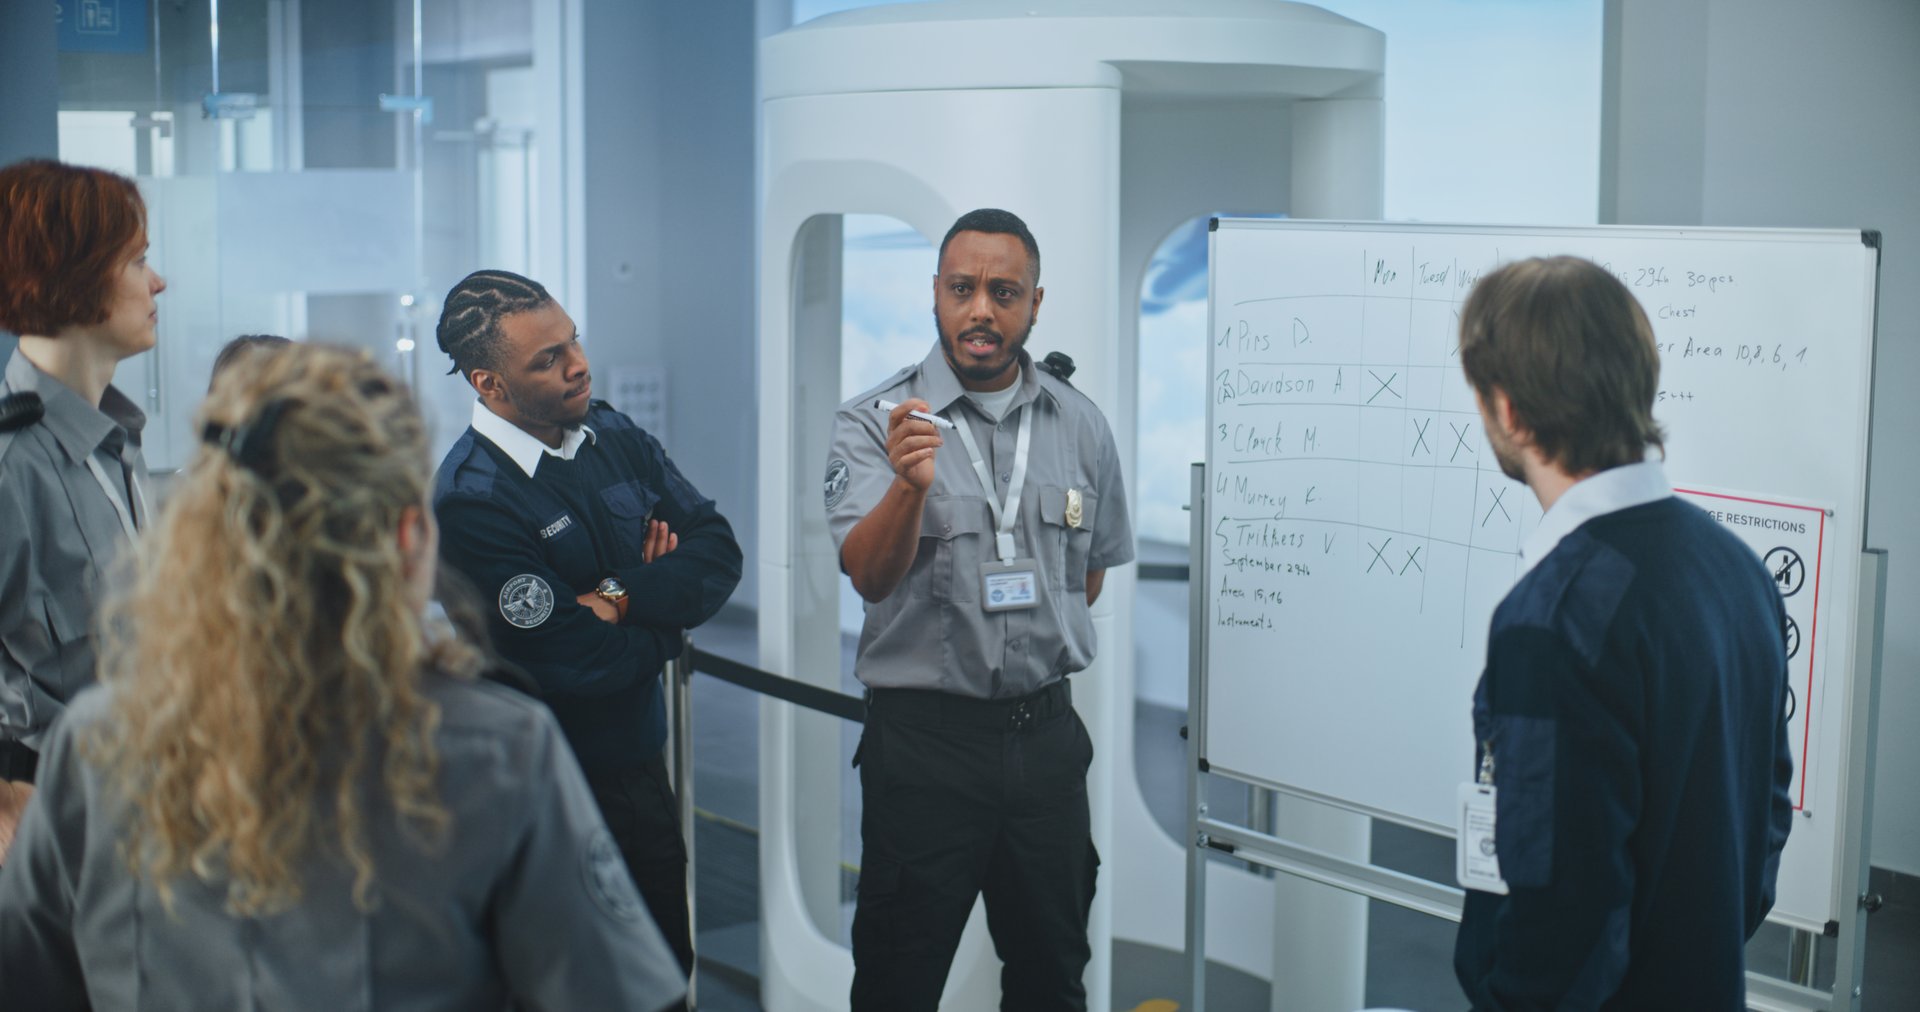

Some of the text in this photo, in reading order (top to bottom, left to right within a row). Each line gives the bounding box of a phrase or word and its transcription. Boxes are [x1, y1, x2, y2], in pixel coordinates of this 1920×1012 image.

[1373, 258, 1397, 285] Mon
[1658, 304, 1697, 320] Chest
[1683, 336, 1722, 359] Area
[1237, 368, 1315, 397] Davidson
[1726, 512, 1806, 535] RESTRICTIONS
[1222, 549, 1283, 573] September
[503, 577, 527, 600] AIRPORT
[1221, 574, 1246, 598] Area
[524, 602, 551, 625] SECURITY
